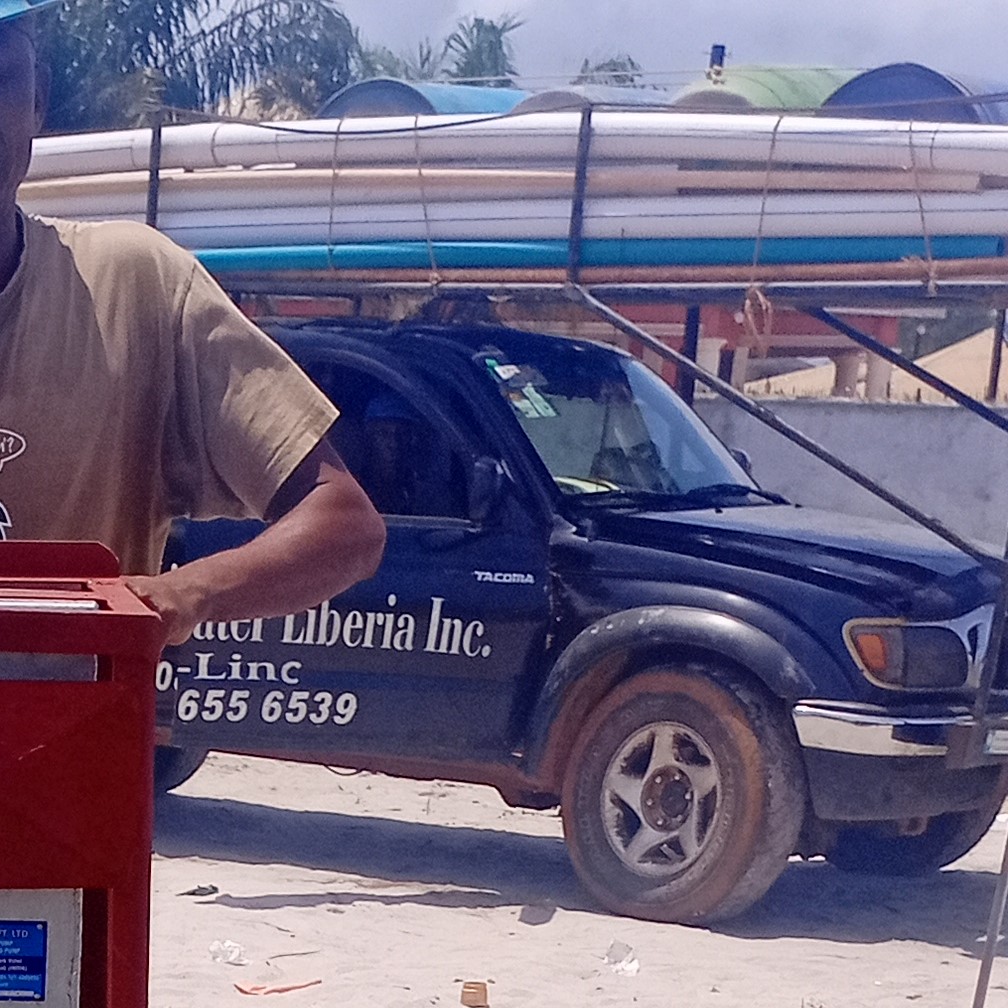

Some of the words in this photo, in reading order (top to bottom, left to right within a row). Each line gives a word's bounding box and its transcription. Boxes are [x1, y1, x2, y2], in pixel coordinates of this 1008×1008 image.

[473, 570, 535, 584] TACOMA
[281, 594, 415, 651] Liberia
[422, 596, 491, 658] Inc.
[177, 690, 250, 722] 655
[261, 691, 358, 725] 6539
